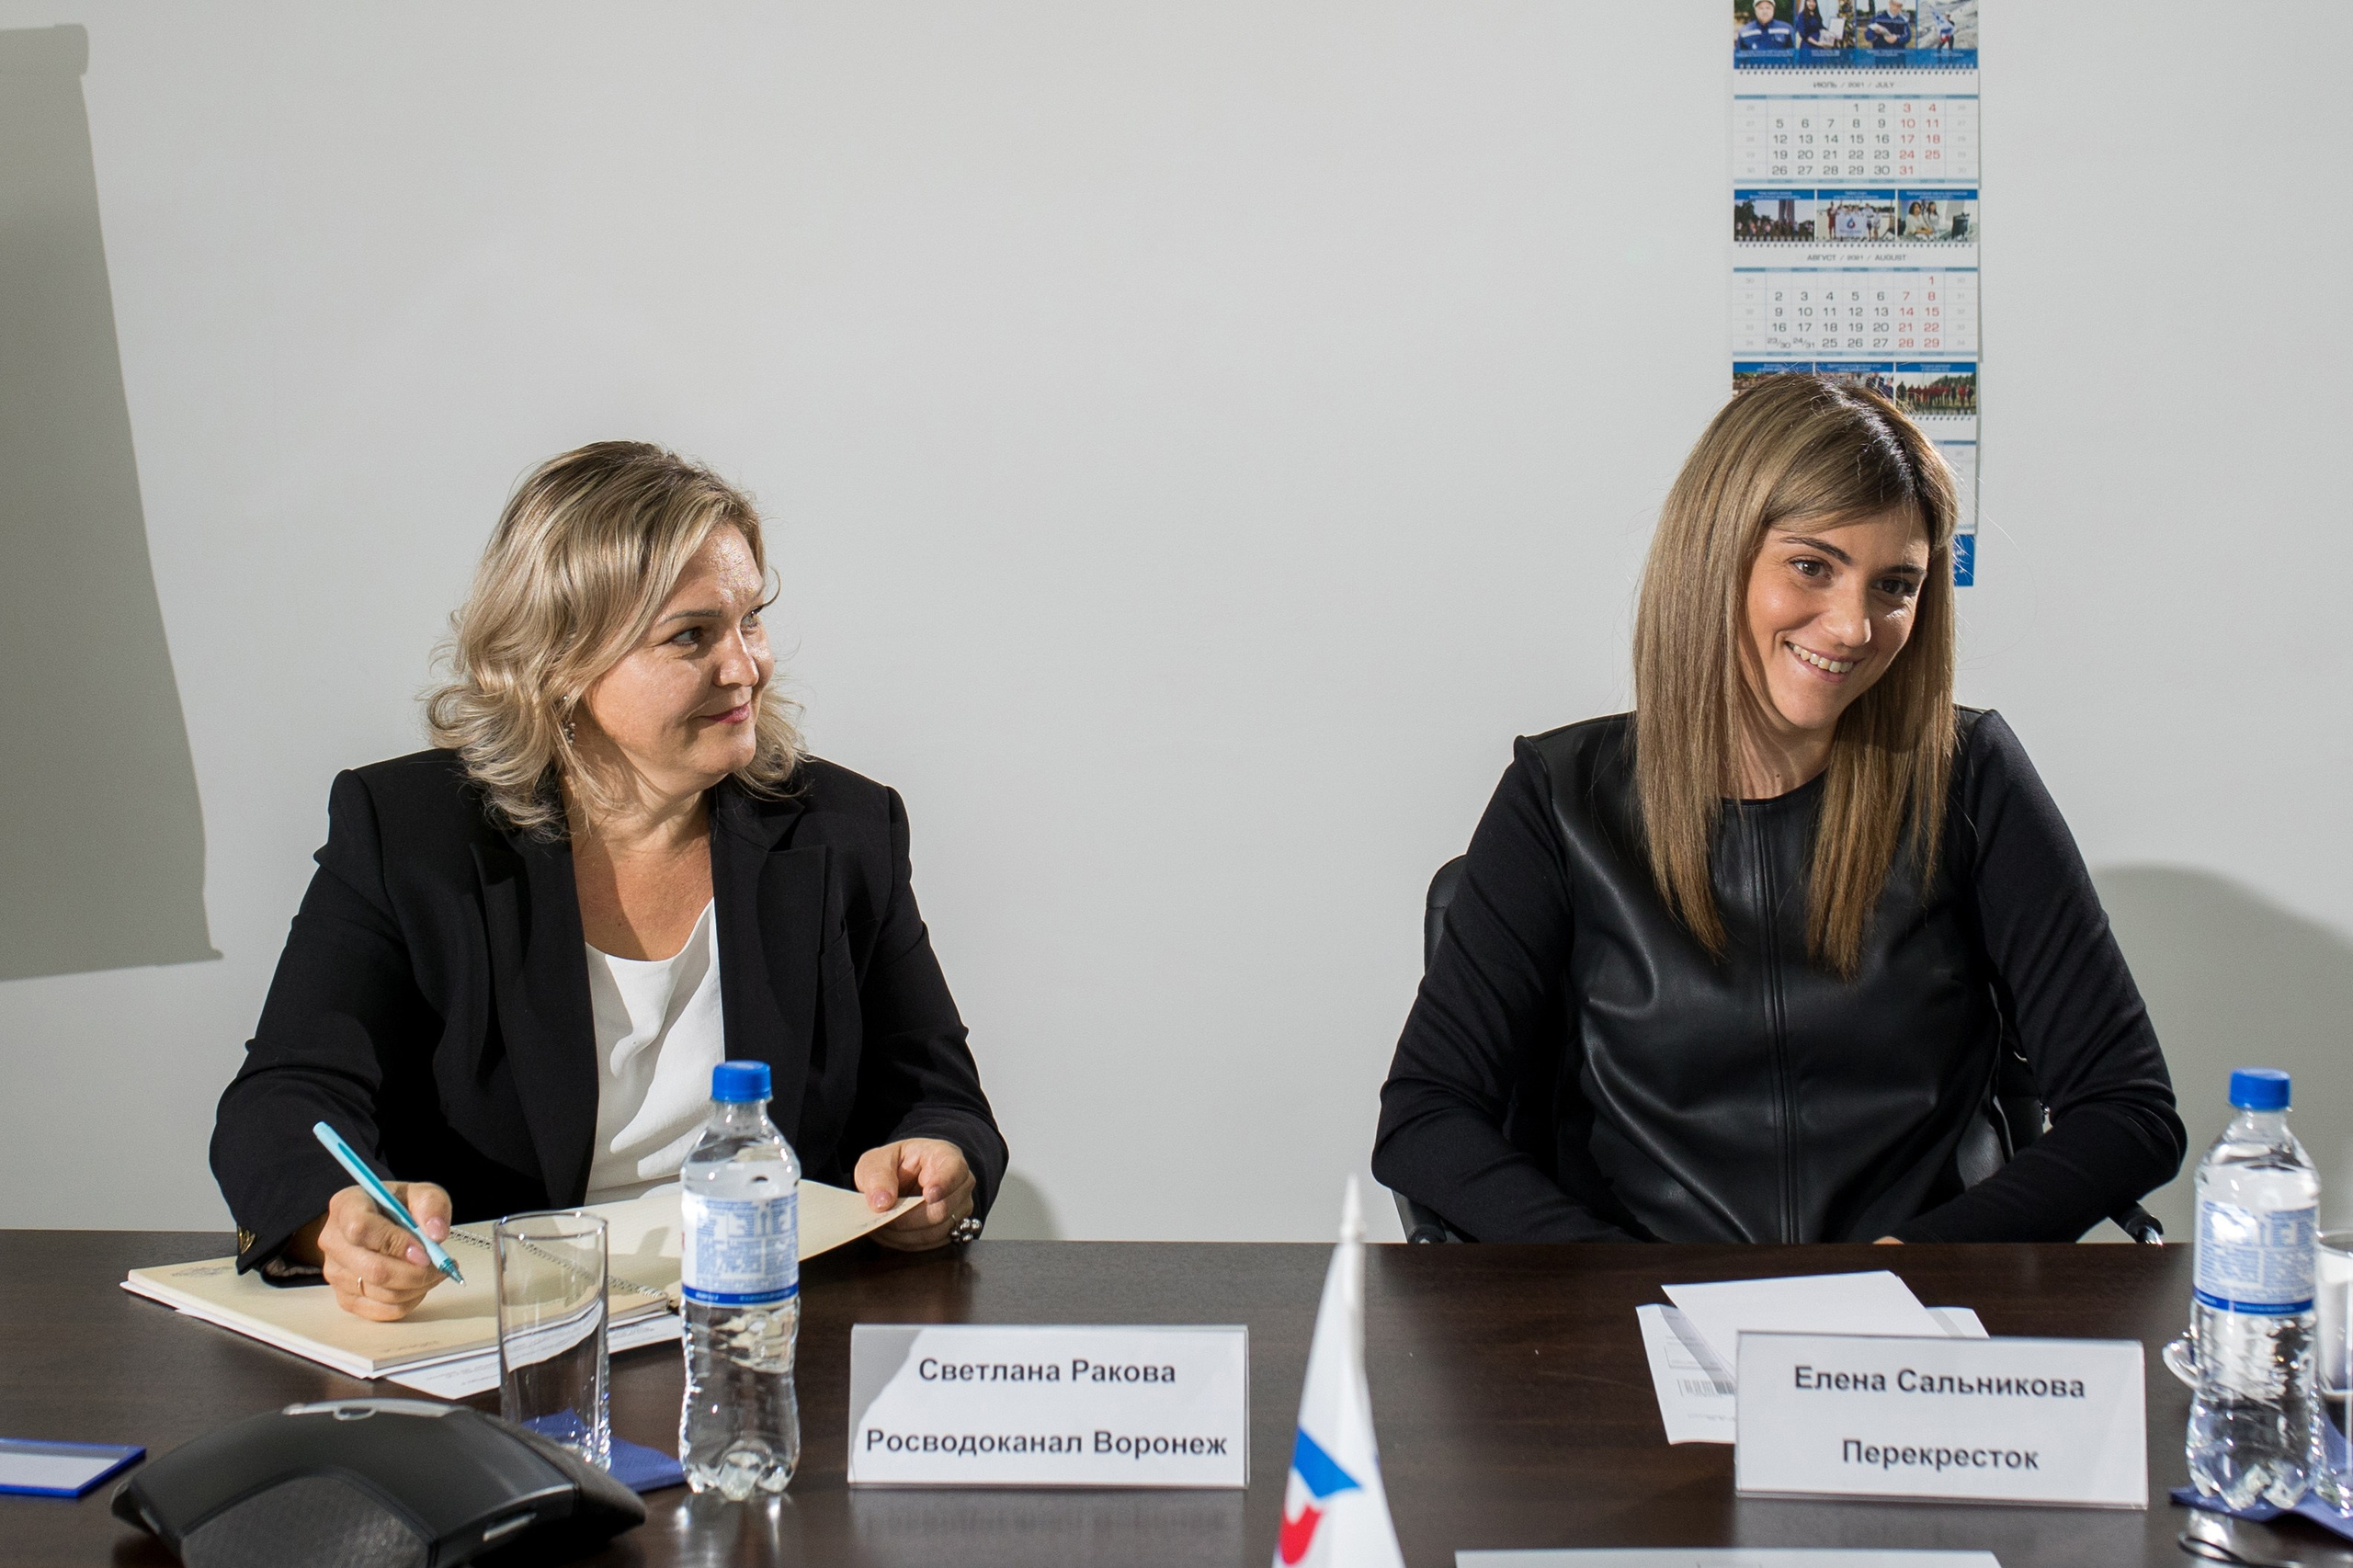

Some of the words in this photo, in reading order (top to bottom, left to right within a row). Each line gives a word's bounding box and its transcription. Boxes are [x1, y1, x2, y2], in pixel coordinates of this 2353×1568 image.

[1875, 81, 1895, 89] JULY
[1853, 103, 1859, 113] 1
[1878, 103, 1886, 113] 2
[1903, 103, 1912, 113] 3
[1928, 103, 1937, 113] 4
[1776, 119, 1784, 129] 5
[1801, 119, 1810, 129] 6
[1827, 119, 1836, 129] 7
[1852, 119, 1861, 129] 8
[1877, 119, 1886, 129] 9
[1901, 119, 1916, 129] 10
[1927, 119, 1939, 129] 11
[1773, 134, 1788, 144] 12
[1799, 134, 1813, 144] 13
[1824, 134, 1839, 144] 14
[1849, 134, 1865, 144] 15
[1875, 134, 1890, 144] 16
[1901, 134, 1915, 144] 17
[1927, 134, 1941, 144] 18
[1773, 150, 1789, 160] 19
[1797, 150, 1814, 160] 20
[1823, 150, 1837, 160] 21
[1847, 150, 1865, 160] 22
[1873, 150, 1891, 160] 23
[1899, 150, 1915, 160] 24
[1925, 150, 1941, 160] 25
[1771, 165, 1788, 176] 26
[1797, 165, 1813, 176] 27
[1823, 165, 1839, 176] 28
[1848, 165, 1864, 176] 29
[1873, 165, 1891, 176] 30
[1899, 165, 1914, 176] 31
[1874, 254, 1907, 262] AUGUST
[1928, 276, 1934, 285] 1
[1775, 291, 1783, 301] 2
[1801, 291, 1809, 301] 3
[1825, 291, 1835, 301] 4
[1851, 291, 1860, 301] 5
[1876, 291, 1885, 301] 6
[1903, 291, 1911, 301] 7
[1927, 291, 1936, 301] 8
[1774, 307, 1783, 317] 9
[1797, 307, 1813, 317] 10
[1823, 307, 1836, 317] 11
[1848, 307, 1863, 317] 12
[1874, 307, 1889, 317] 13
[1899, 307, 1915, 317] 14
[1925, 307, 1940, 317] 15
[1772, 323, 1787, 333] 16
[1798, 323, 1813, 333] 17
[1823, 323, 1838, 333] 18
[1848, 323, 1864, 333] 19
[1872, 323, 1890, 333] 20
[1898, 323, 1913, 333] 21
[1924, 323, 1939, 333] 22
[1822, 338, 1838, 348] 25
[1847, 338, 1863, 348] 26
[1872, 338, 1889, 348] 27
[1898, 338, 1915, 348] 28
[1924, 338, 1940, 348] 29
[919, 1358, 1061, 1381] Светлана
[1072, 1359, 1176, 1383] Ракова
[1794, 1365, 1887, 1392] Елена
[1896, 1369, 2086, 1398] Сальникова
[867, 1428, 1083, 1456] Росводоканал
[1093, 1431, 1227, 1460] Воронеж
[1843, 1439, 2039, 1472] Перекресток
